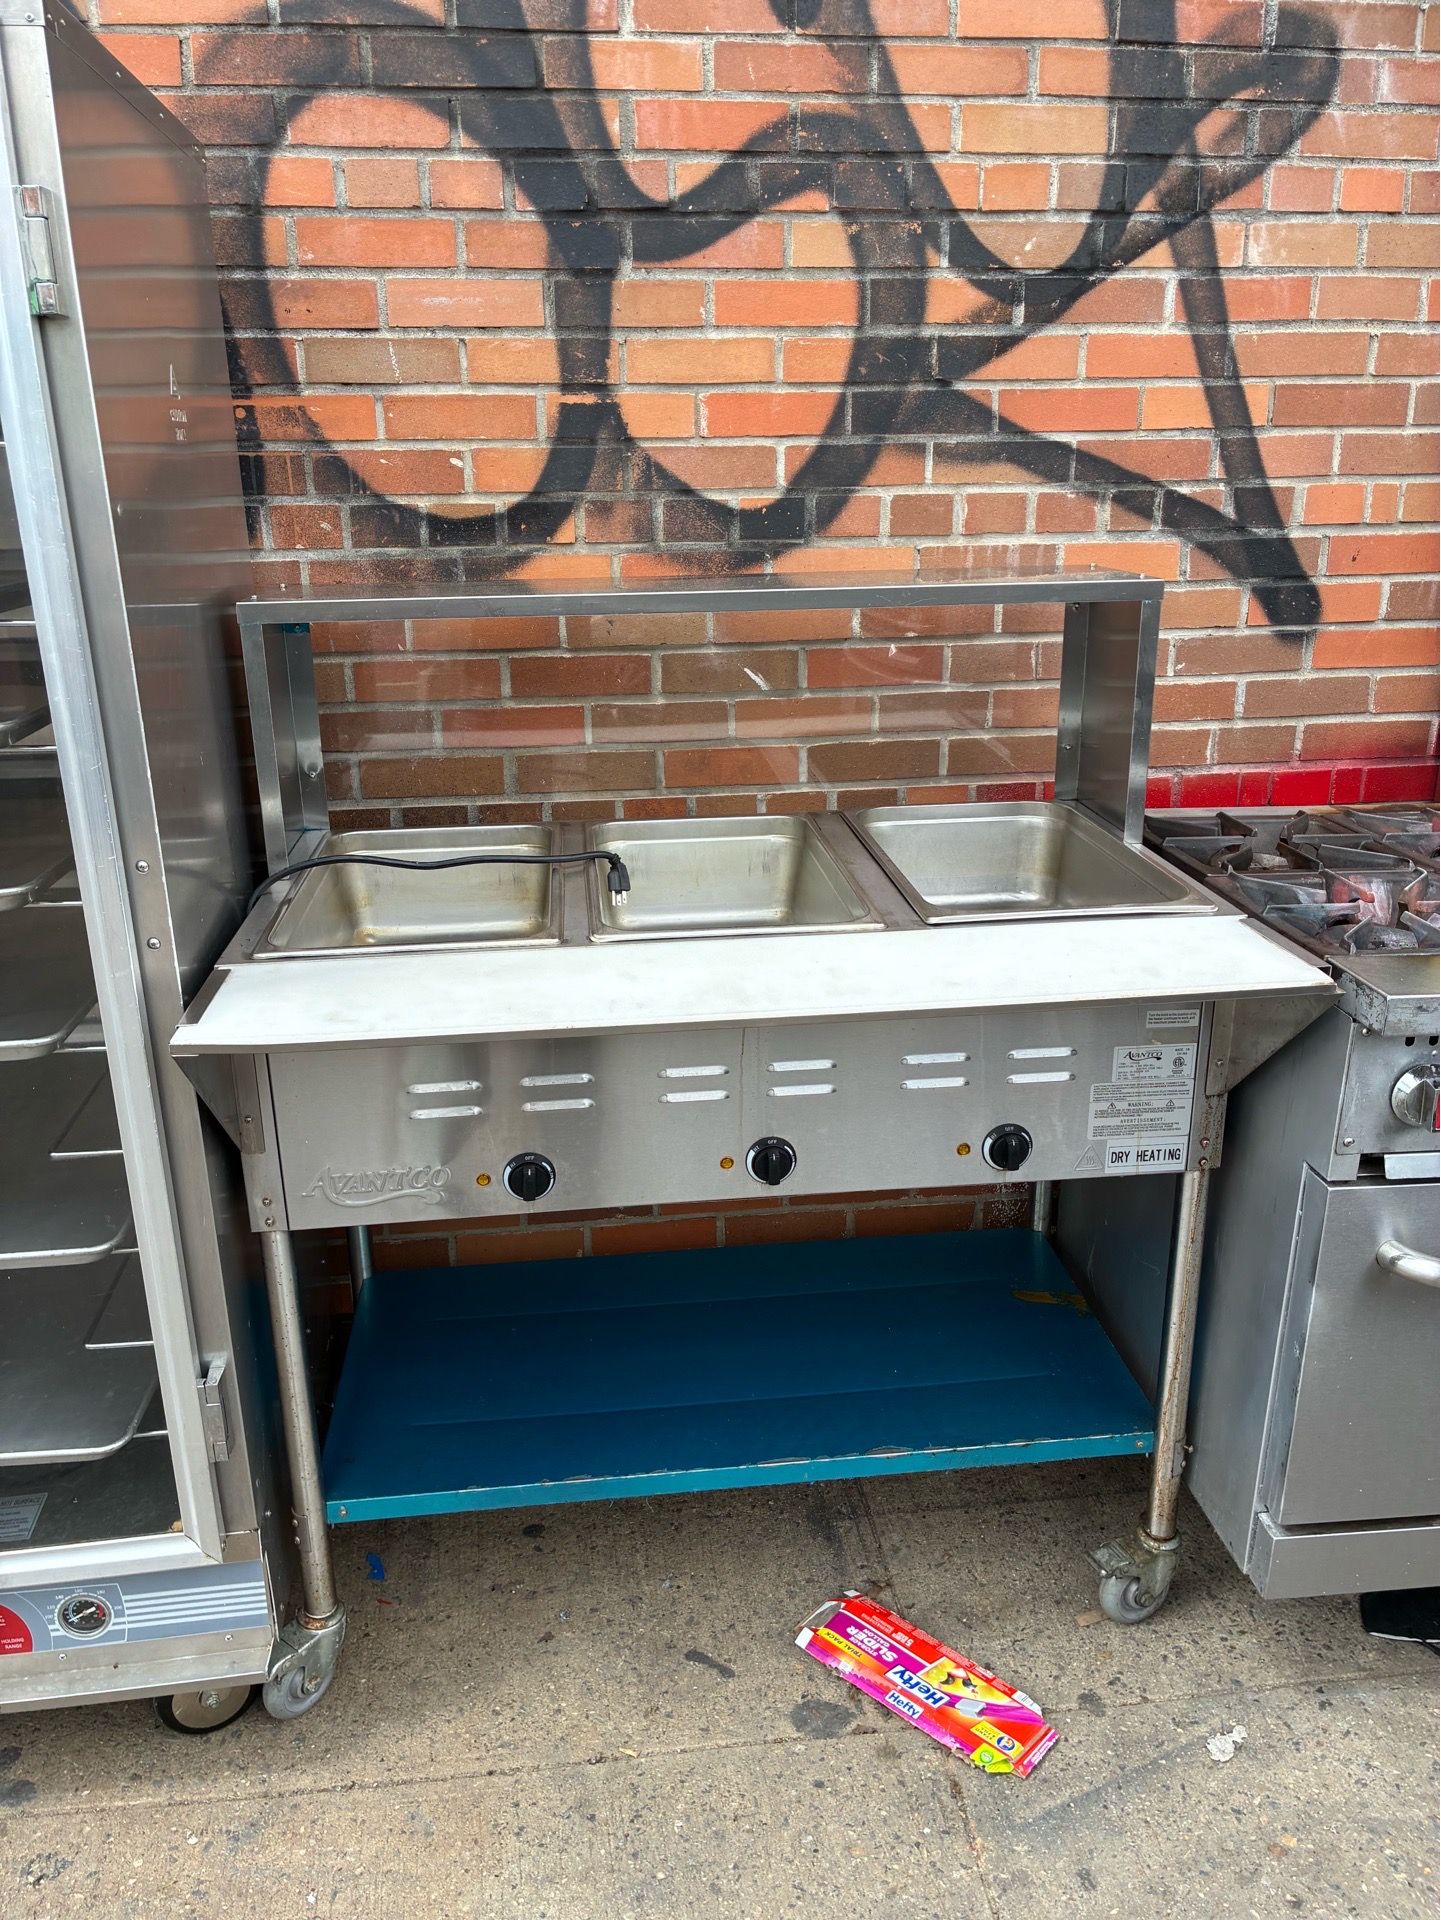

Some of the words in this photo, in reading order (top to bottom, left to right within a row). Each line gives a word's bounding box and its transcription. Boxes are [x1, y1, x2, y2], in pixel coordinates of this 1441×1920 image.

[1111, 1150, 1131, 1164] DRY
[1136, 1148, 1181, 1163] HEATING
[301, 1165, 452, 1208] AVANTCO
[826, 1631, 843, 1645] PACK
[846, 1625, 899, 1662] SLIDER
[849, 1636, 879, 1657] STORAGE
[862, 1628, 890, 1648] GALLON
[844, 1643, 863, 1658] TRIAL
[892, 1669, 945, 1706] Hefty
[888, 1692, 920, 1717] Hefty
